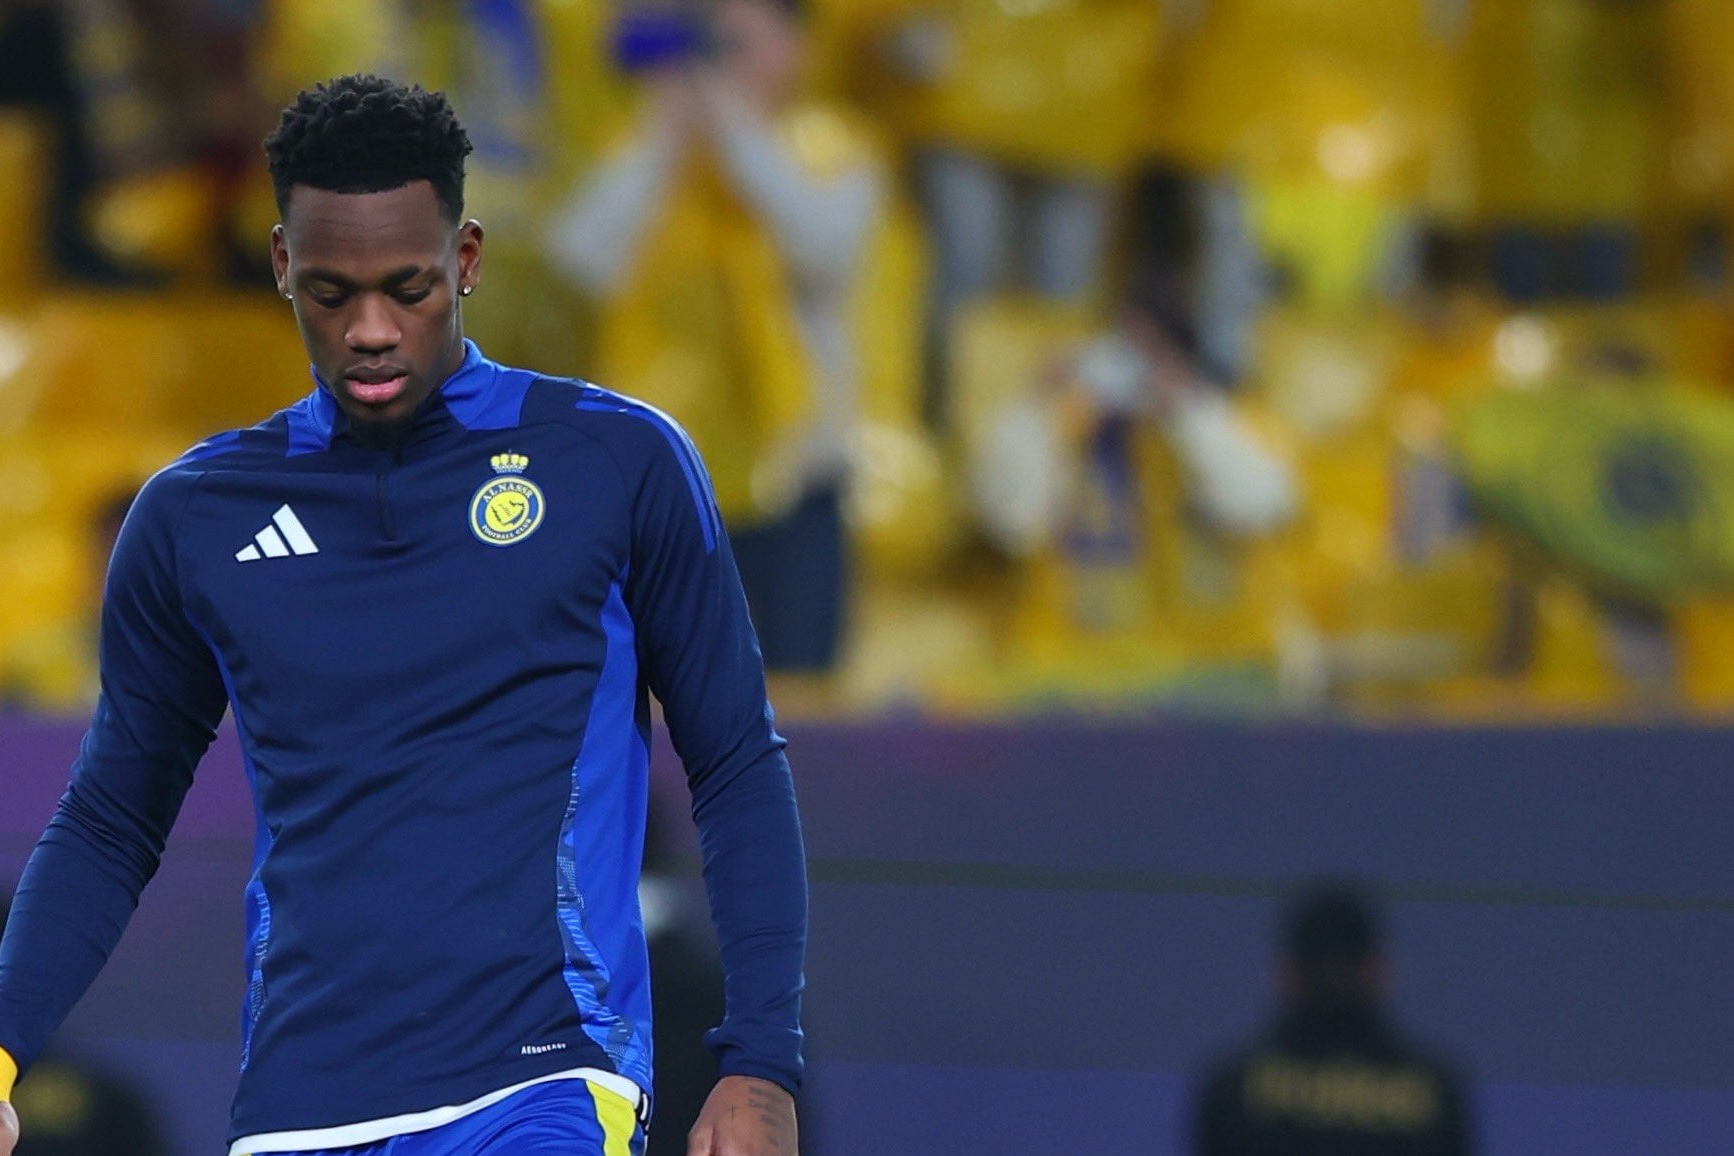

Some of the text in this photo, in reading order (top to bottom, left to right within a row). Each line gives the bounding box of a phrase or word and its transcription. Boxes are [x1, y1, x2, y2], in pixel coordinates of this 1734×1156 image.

[482, 483, 534, 503] AL NASSR
[482, 518, 533, 539] FOOTBALL CLUB
